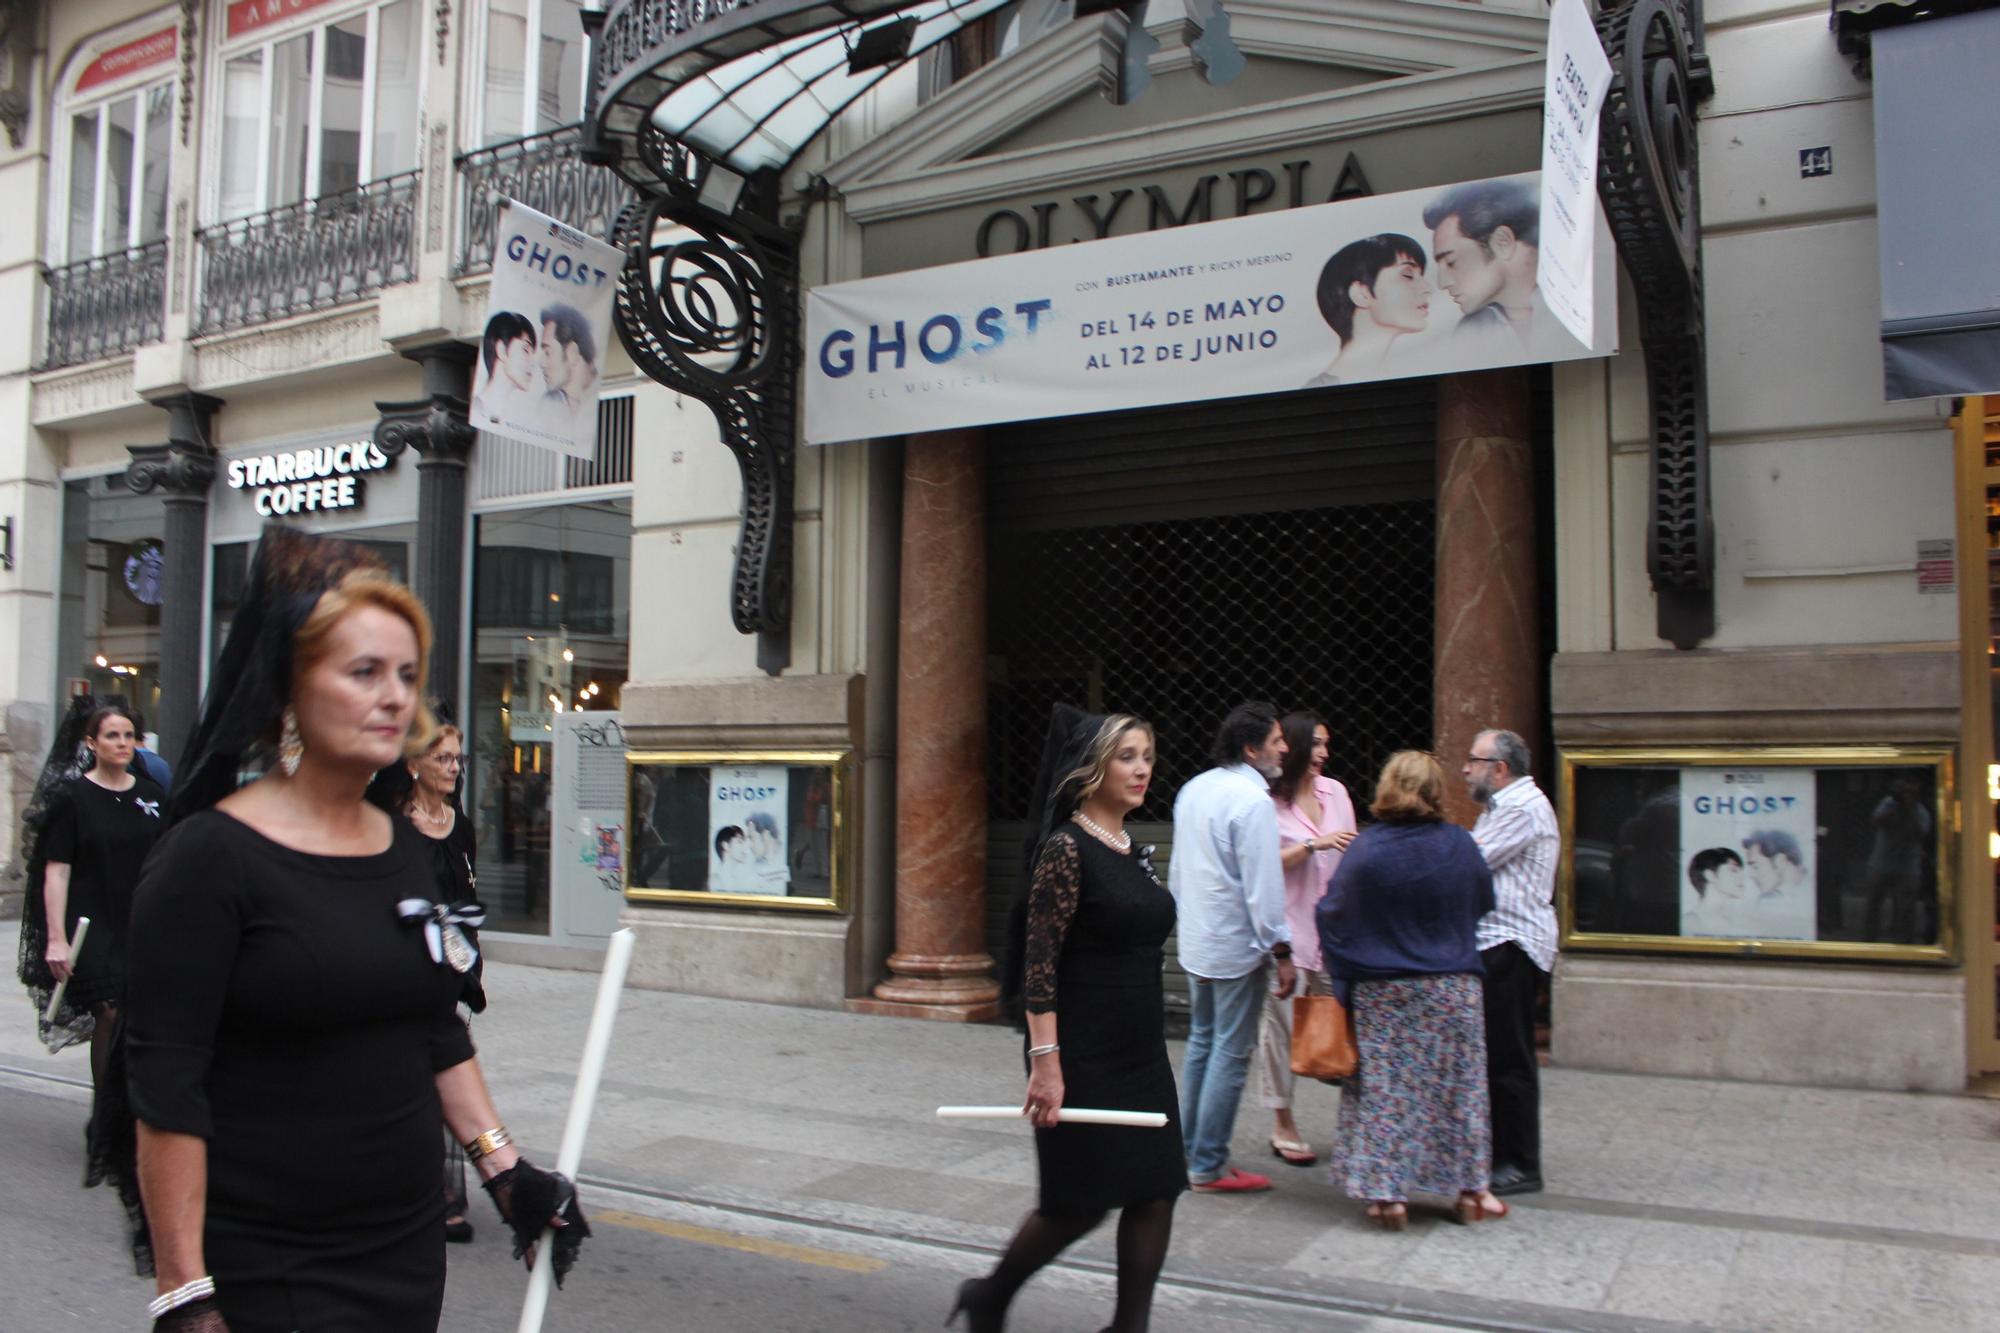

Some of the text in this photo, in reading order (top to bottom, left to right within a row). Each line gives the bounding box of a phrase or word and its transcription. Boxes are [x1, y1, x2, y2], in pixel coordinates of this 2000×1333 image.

[1562, 52, 1589, 109] TEATRO
[1555, 76, 1584, 135] OLYMPIA
[1801, 150, 1830, 173] 44
[975, 150, 1376, 259] OLYMPIA
[507, 234, 607, 287] GHOST
[1074, 252, 1293, 293] CON BUSTAMANTE Y RICKY MERINO
[1080, 294, 1285, 338] DEL 14 DE MAYO
[819, 299, 1052, 379] GHOST
[1085, 329, 1278, 370] AL 12 DE JUNIO
[867, 373, 1001, 400] EL MUSICAL
[227, 440, 388, 489] STARBUCKS
[254, 475, 356, 517] COFFEE
[718, 786, 777, 801] GHOST
[1694, 796, 1797, 815] GHOST
